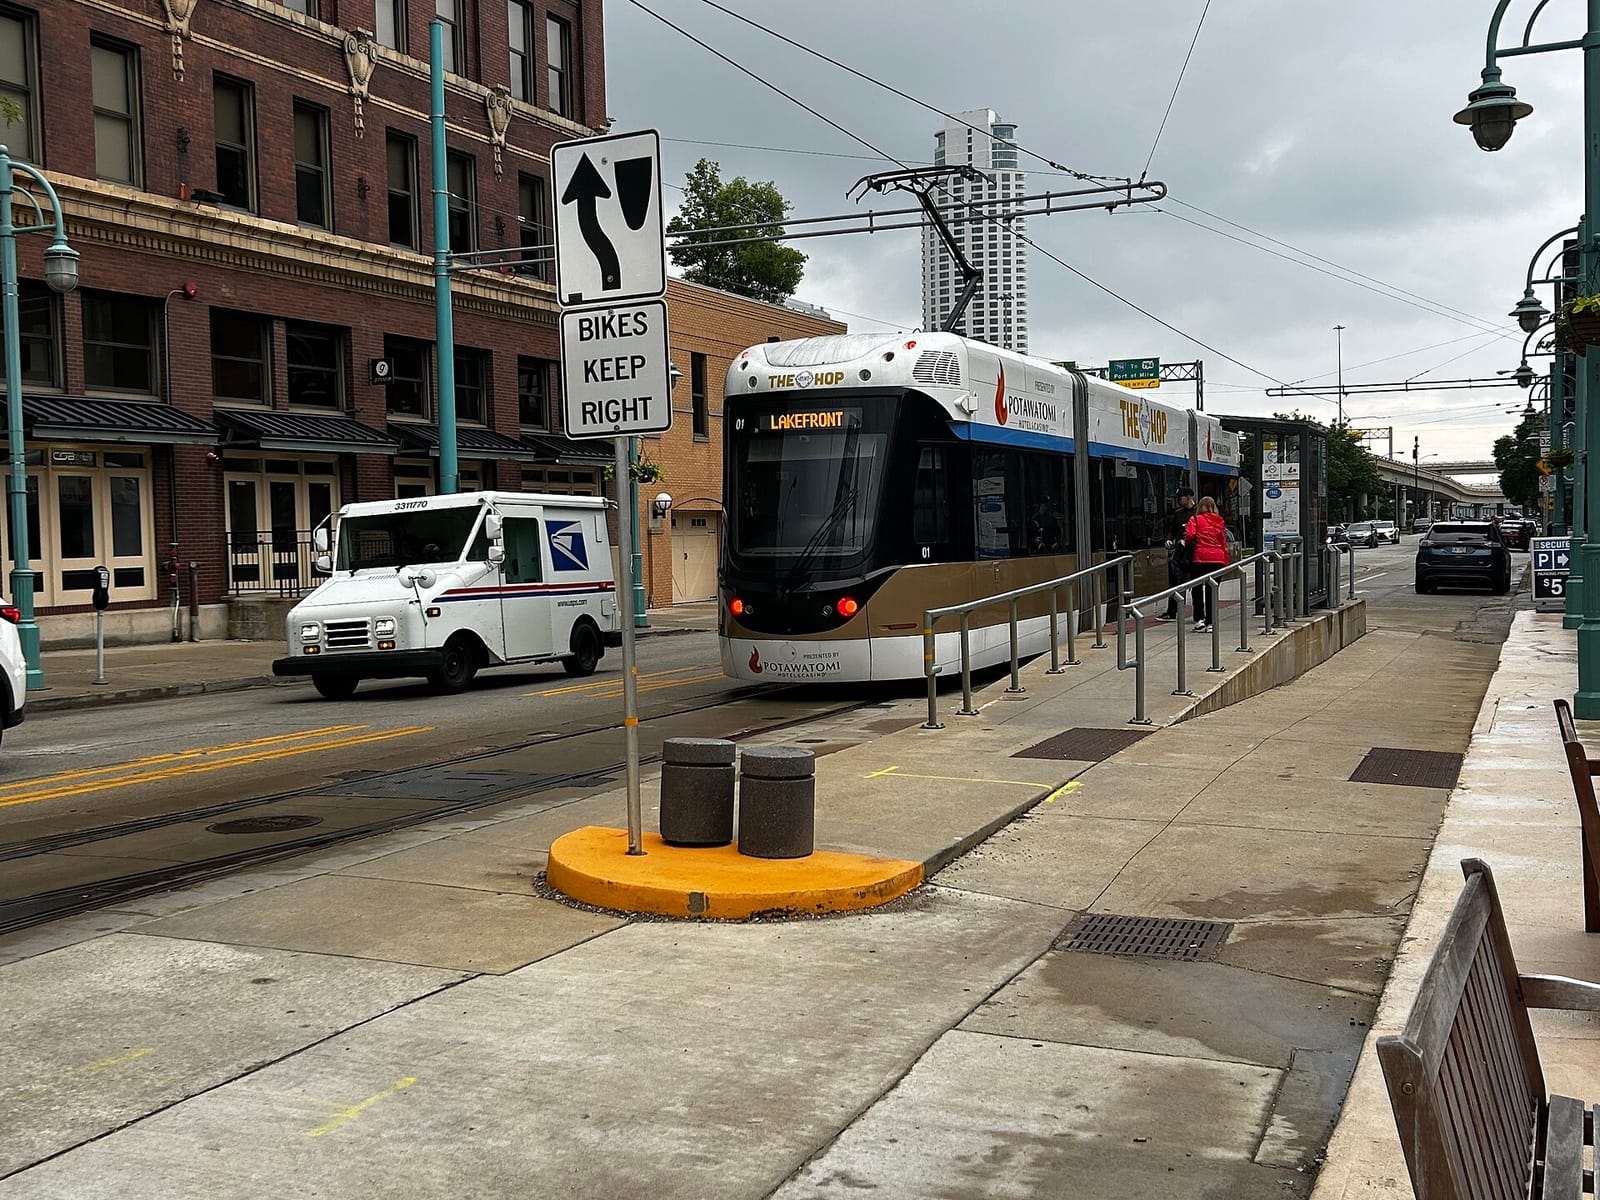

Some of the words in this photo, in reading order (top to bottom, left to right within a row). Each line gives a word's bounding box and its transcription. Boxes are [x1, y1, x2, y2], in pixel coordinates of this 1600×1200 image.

[578, 311, 648, 341] BIKES
[583, 355, 646, 383] KEEP
[768, 375, 795, 388] THE
[814, 372, 844, 386] HOP
[581, 396, 653, 425] RIGHT
[1008, 395, 1056, 422] POTAWATOMI
[735, 418, 745, 430] 01
[770, 411, 843, 430] LAKEFRONT
[1120, 400, 1139, 439] THE
[1150, 408, 1167, 444] HOP
[921, 546, 930, 559] 01
[1538, 553, 1549, 567] P
[1543, 578, 1563, 595] $5
[763, 661, 840, 673] POTAWATOMI
